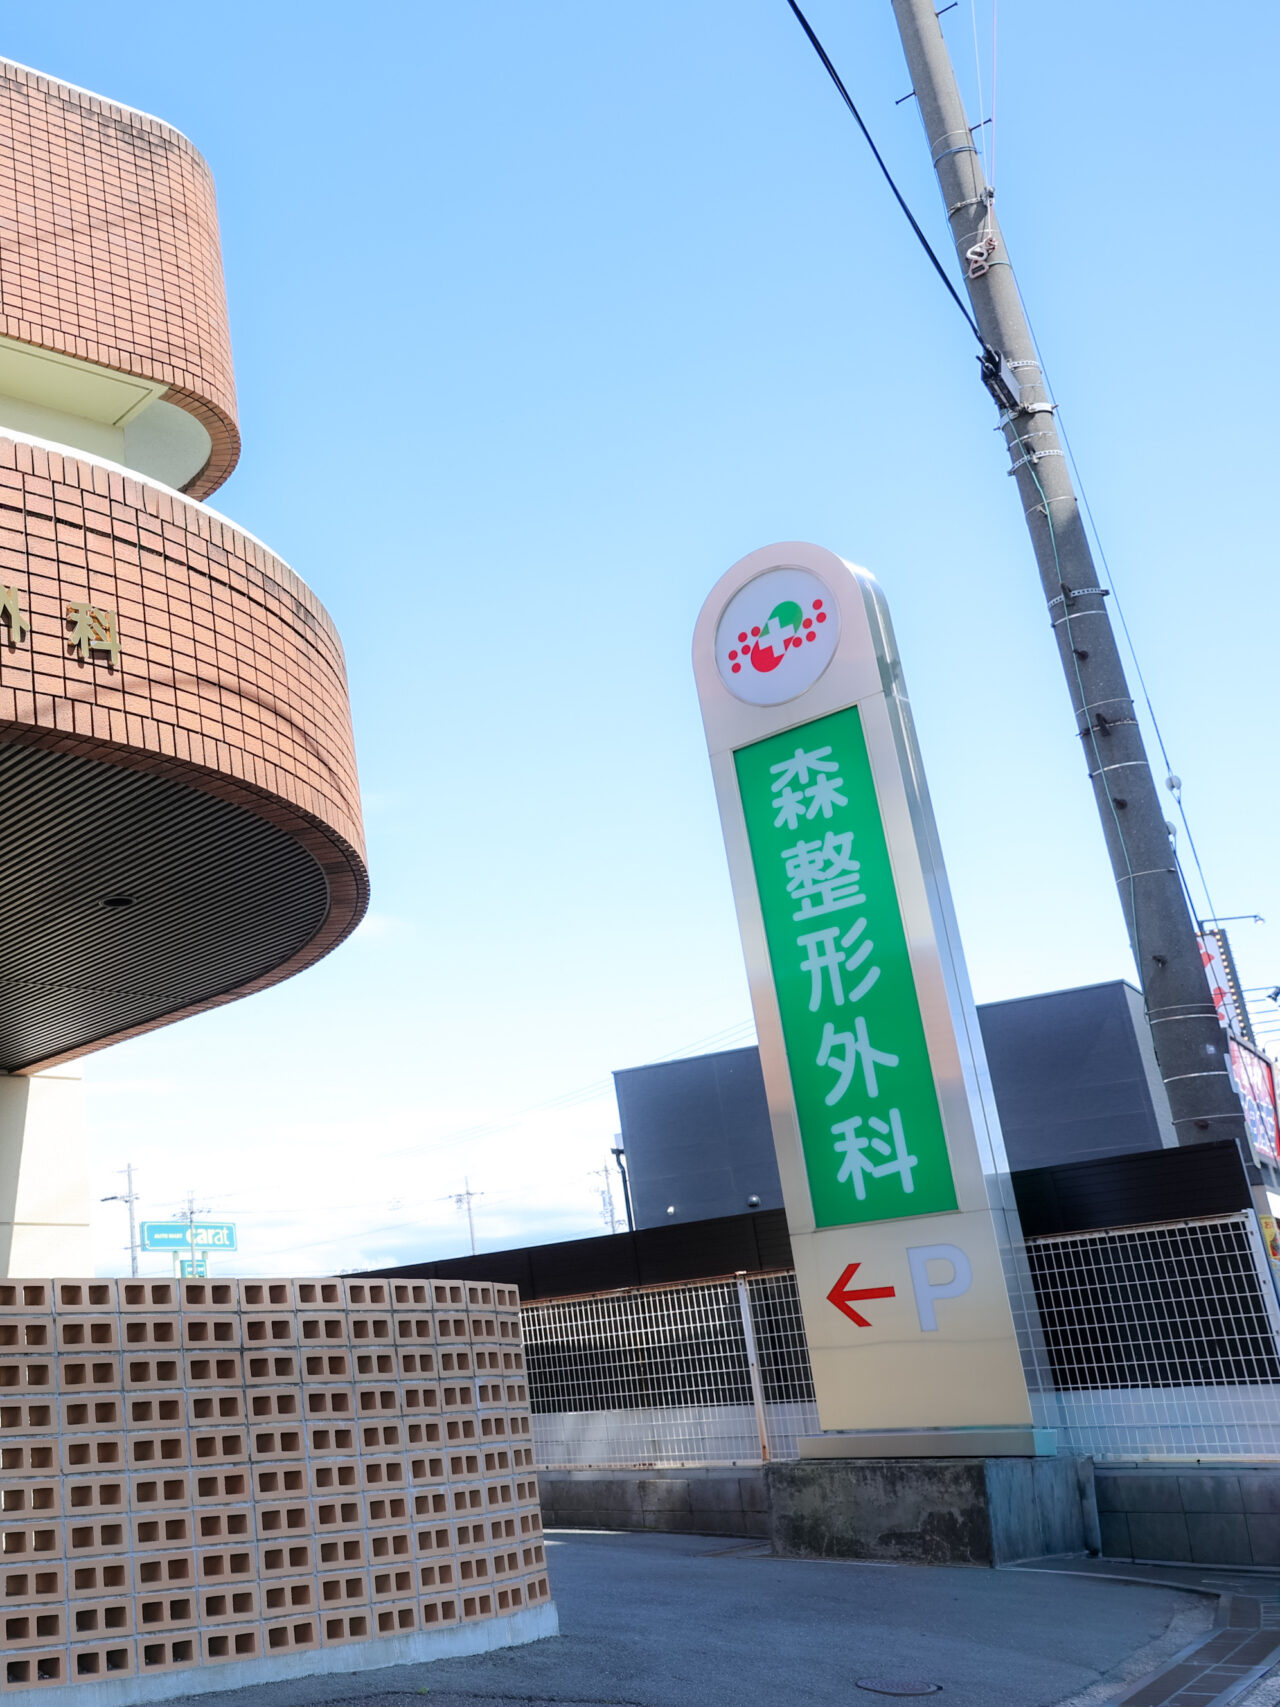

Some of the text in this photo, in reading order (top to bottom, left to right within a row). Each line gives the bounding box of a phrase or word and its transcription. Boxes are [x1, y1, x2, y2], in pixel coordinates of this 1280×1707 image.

[770, 745, 918, 1201] 森整形外科
[906, 1243, 973, 1332] P
